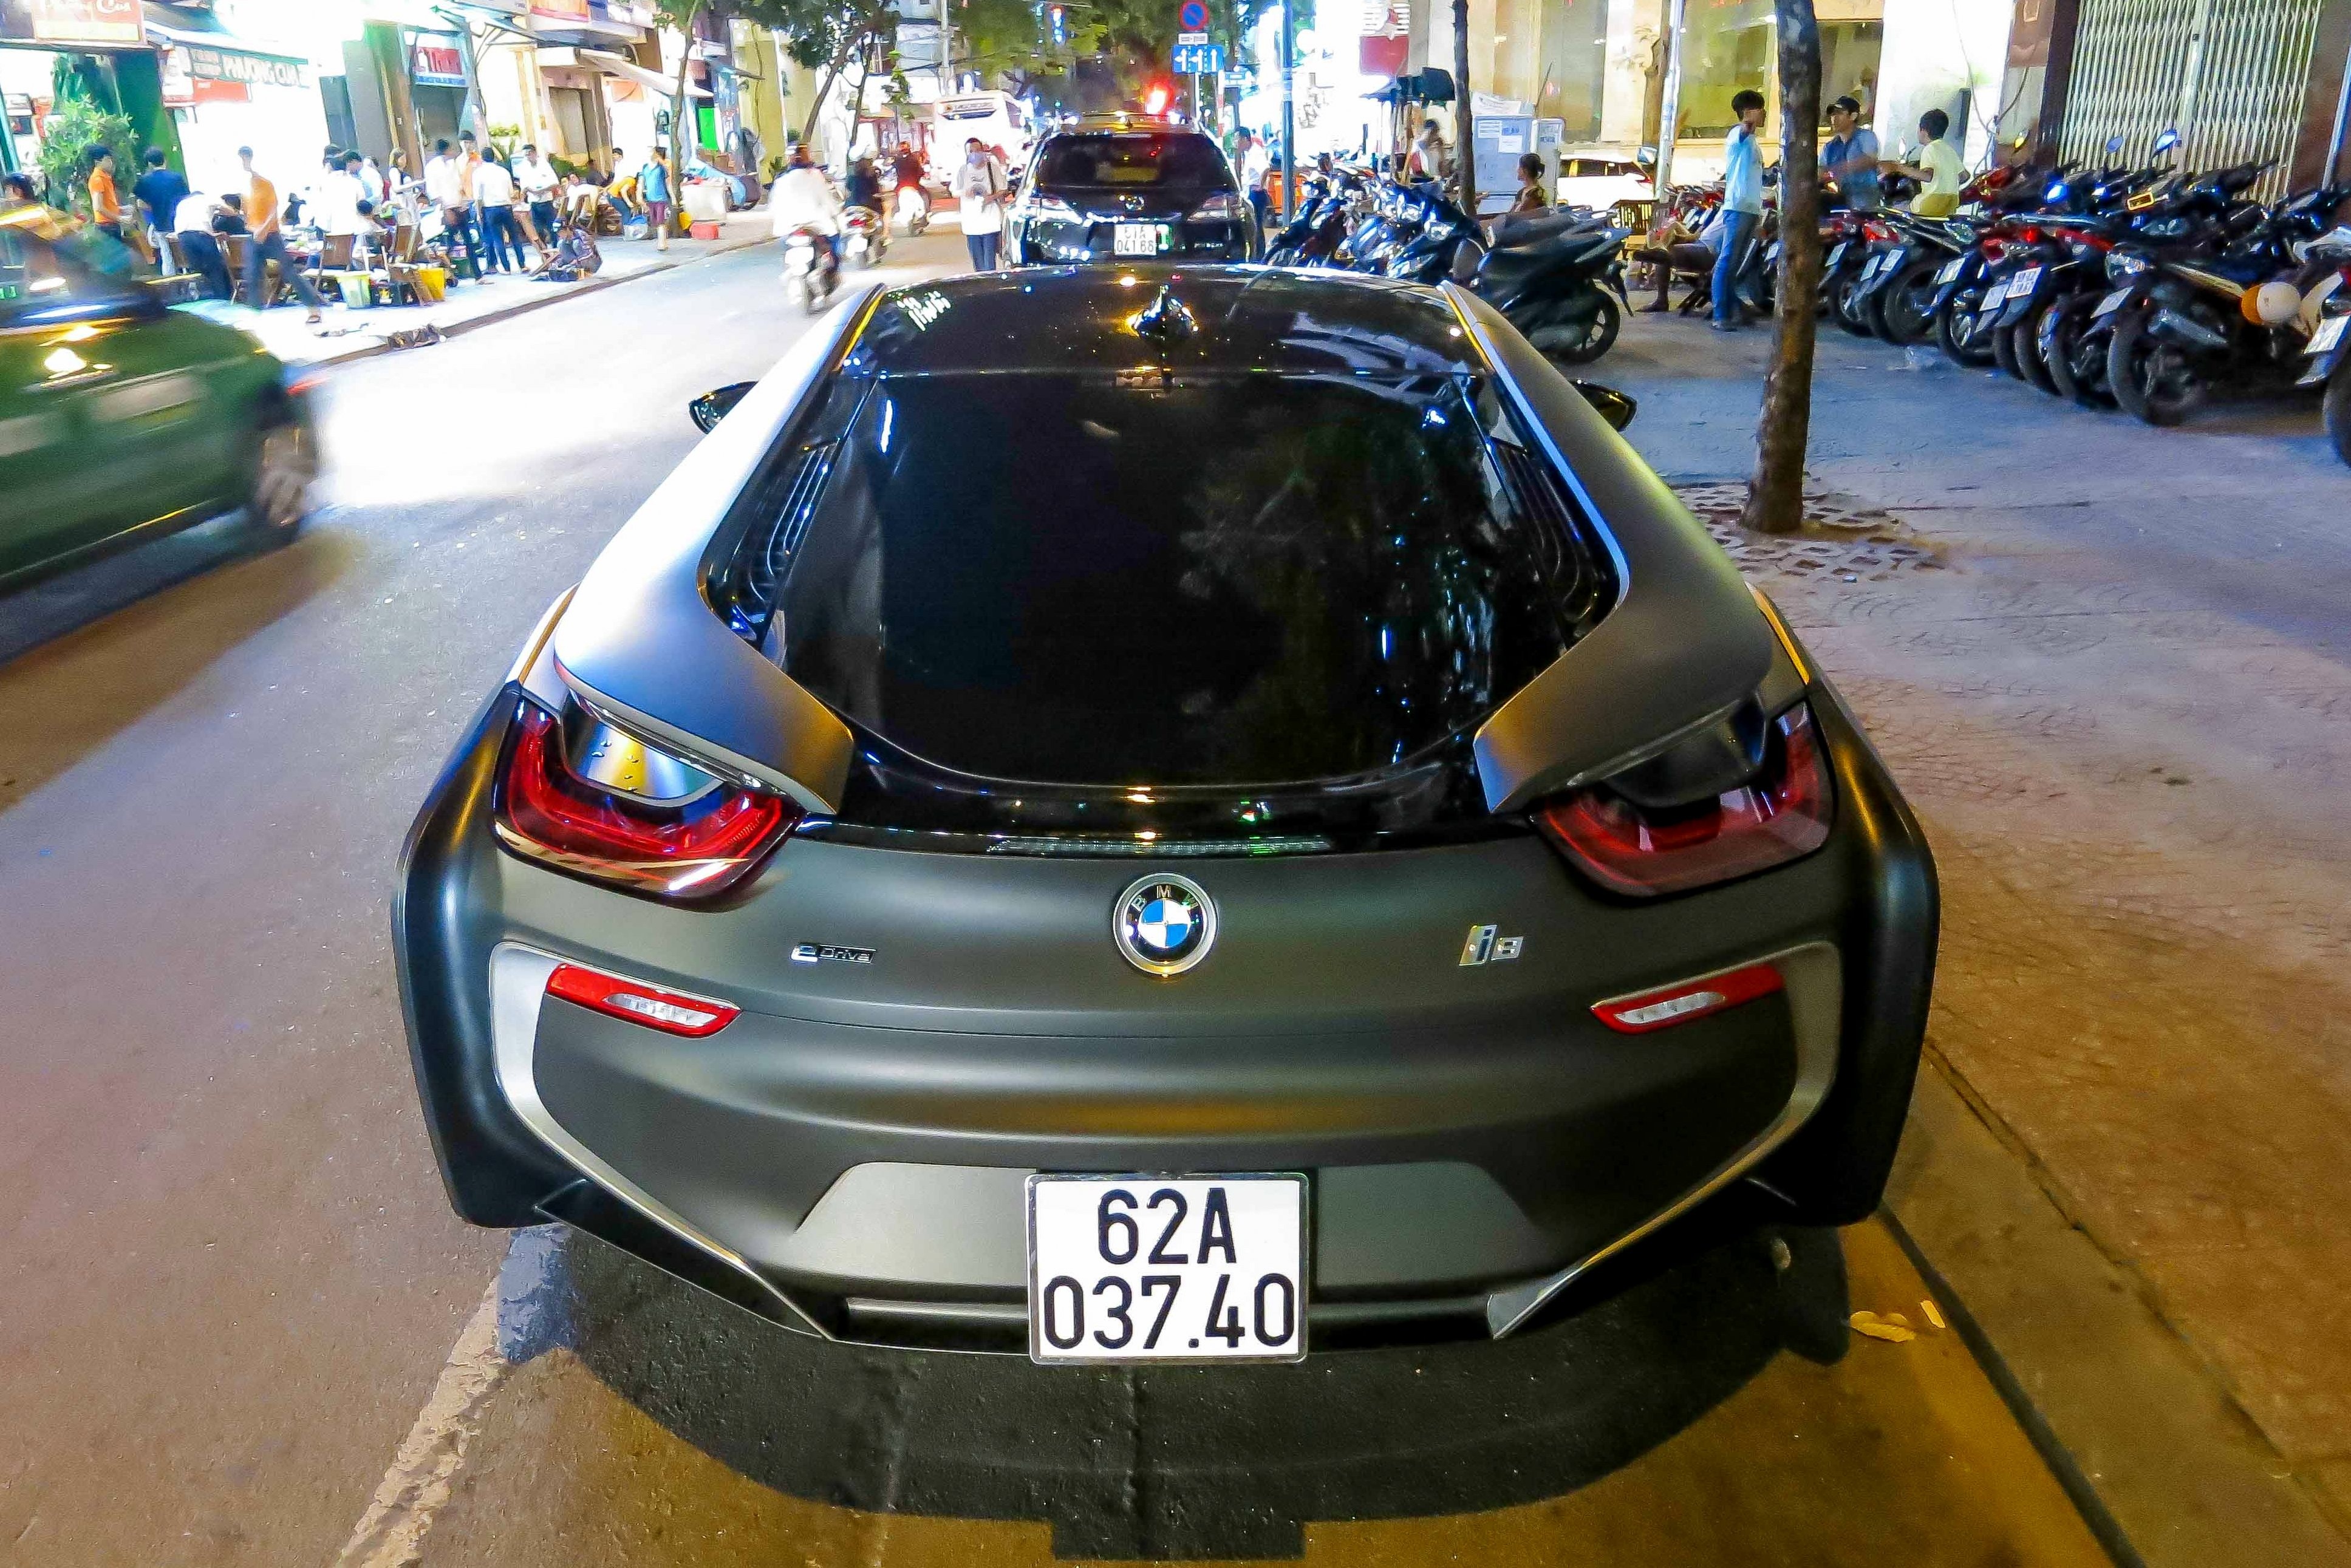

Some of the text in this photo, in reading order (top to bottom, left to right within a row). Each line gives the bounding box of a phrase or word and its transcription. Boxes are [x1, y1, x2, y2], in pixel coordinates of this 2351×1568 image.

[1131, 884, 1198, 912] BMW
[1459, 924, 1523, 966] i8
[1098, 1187, 1237, 1264] 62A
[1043, 1273, 1294, 1349] 037.40
